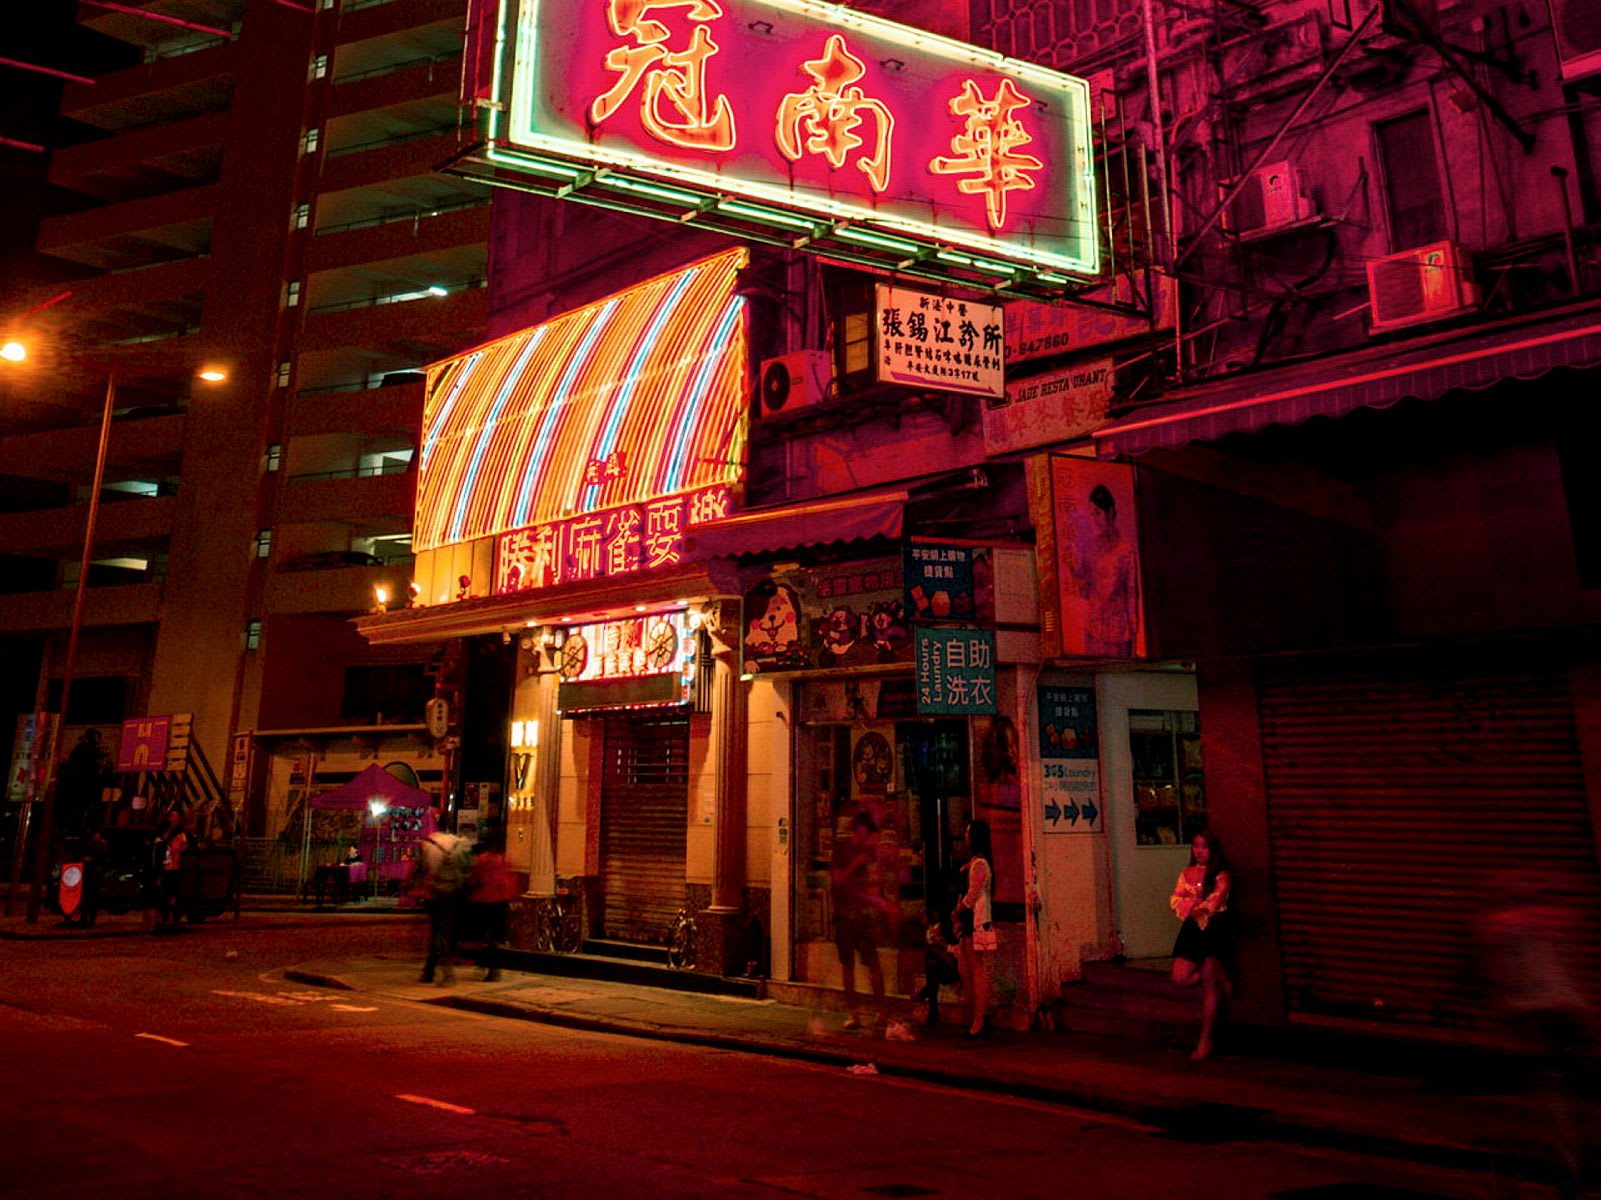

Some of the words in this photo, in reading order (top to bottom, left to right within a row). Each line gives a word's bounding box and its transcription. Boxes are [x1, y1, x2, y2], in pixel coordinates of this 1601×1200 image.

[882, 307, 1003, 356] 張錫江診所
[920, 637, 930, 683] Hours
[932, 640, 943, 703] Laundry
[946, 638, 991, 670] 自助
[920, 688, 931, 704] 24
[946, 674, 993, 706] 洗衣
